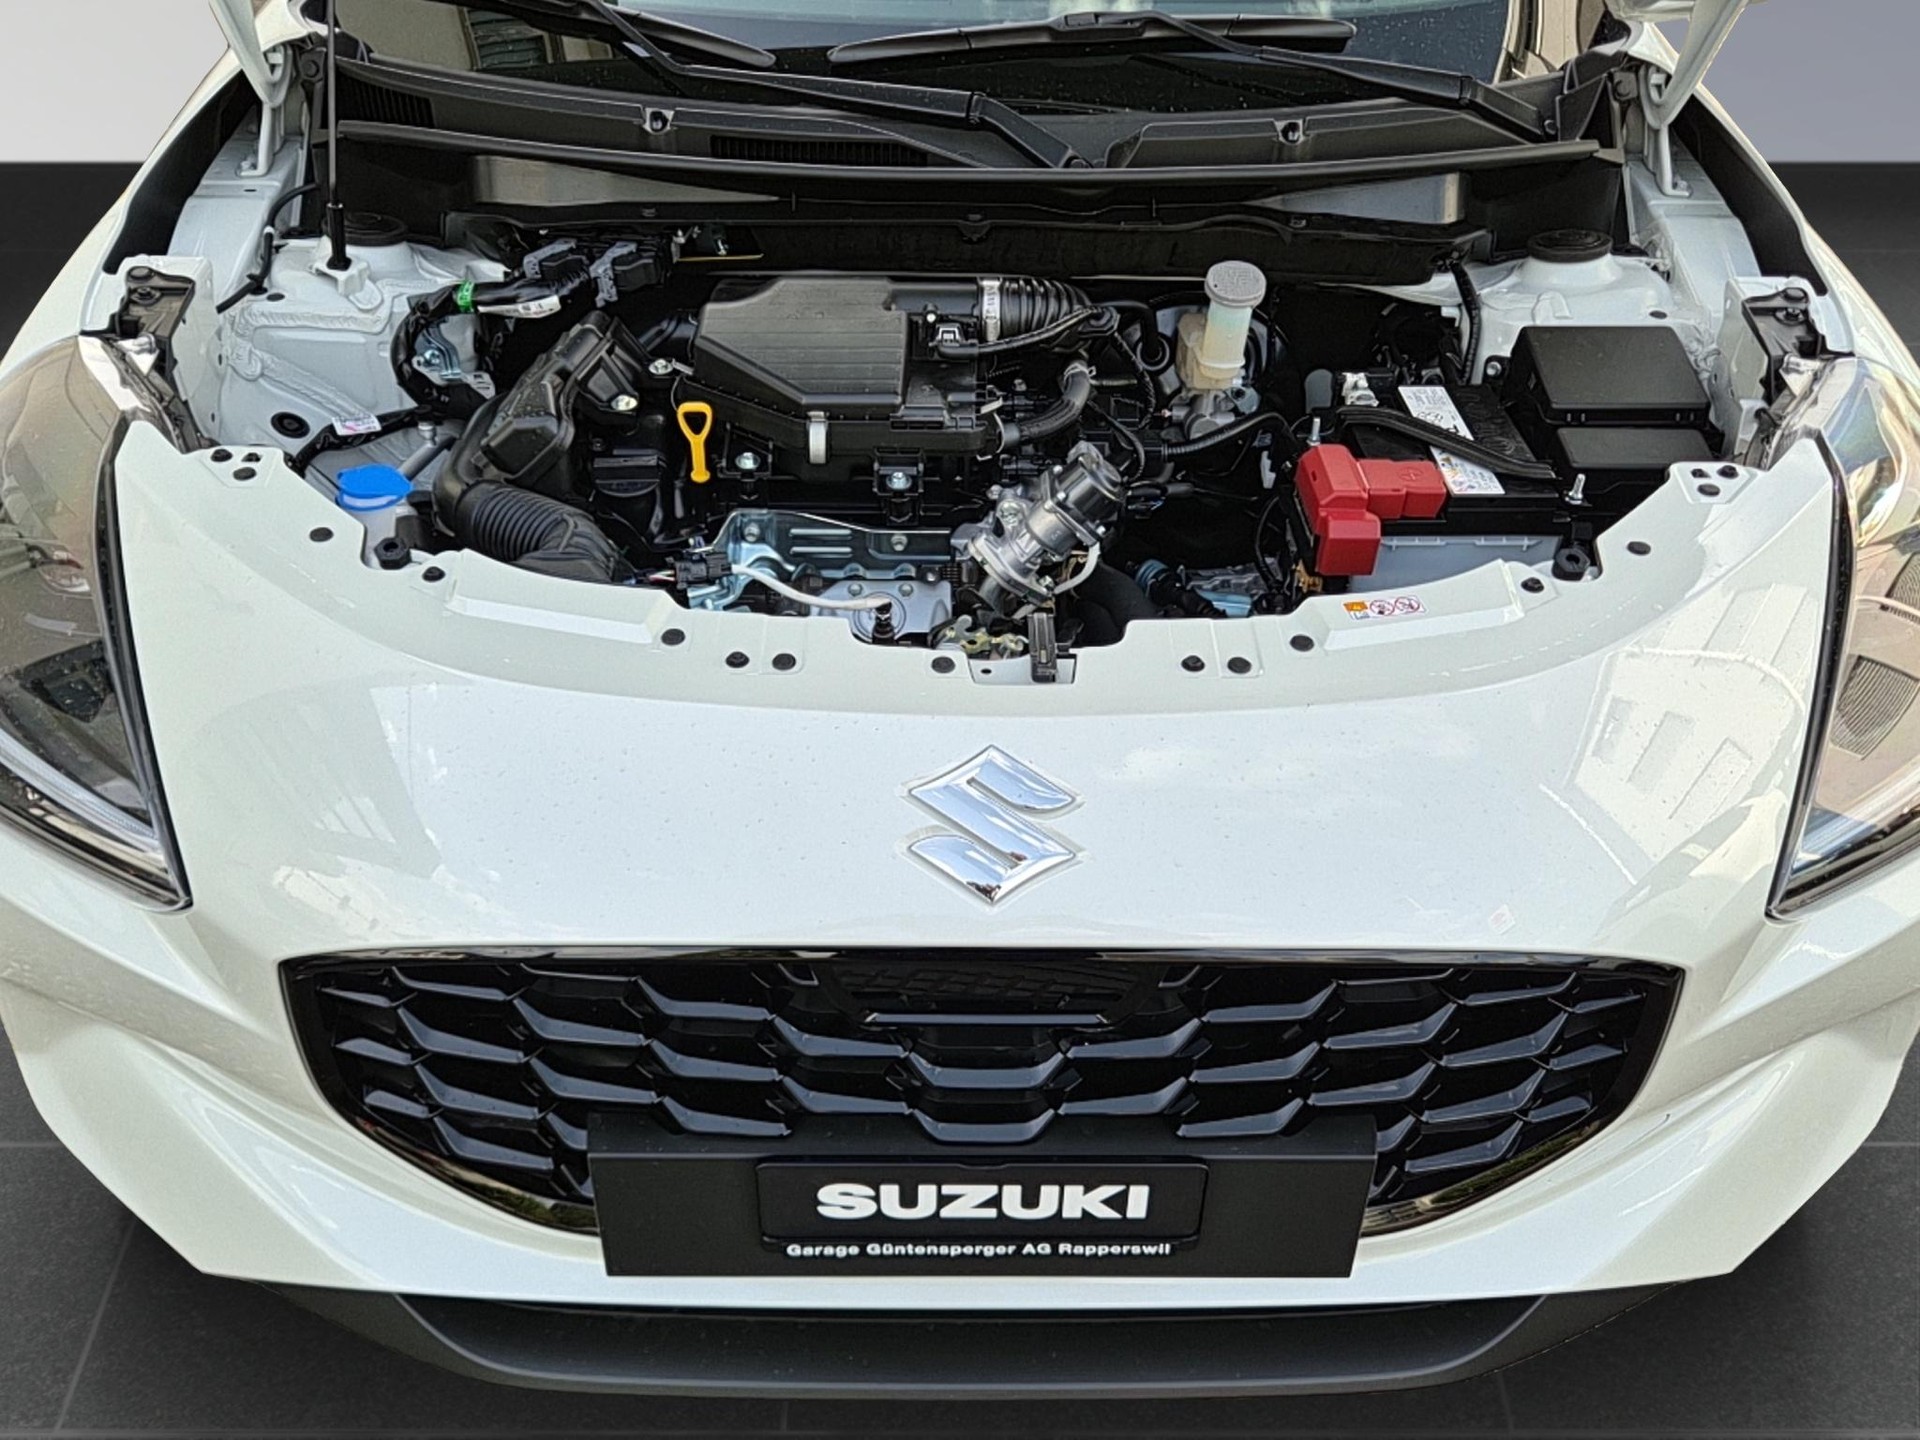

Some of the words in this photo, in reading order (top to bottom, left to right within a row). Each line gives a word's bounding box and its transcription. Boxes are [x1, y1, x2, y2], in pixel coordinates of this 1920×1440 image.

[816, 1183, 1150, 1220] SUZUKI
[786, 1243, 860, 1259] Garage
[866, 1243, 1017, 1258] Güntensperger
[1021, 1243, 1052, 1256] AG
[1057, 1243, 1171, 1258] Rapperswil
